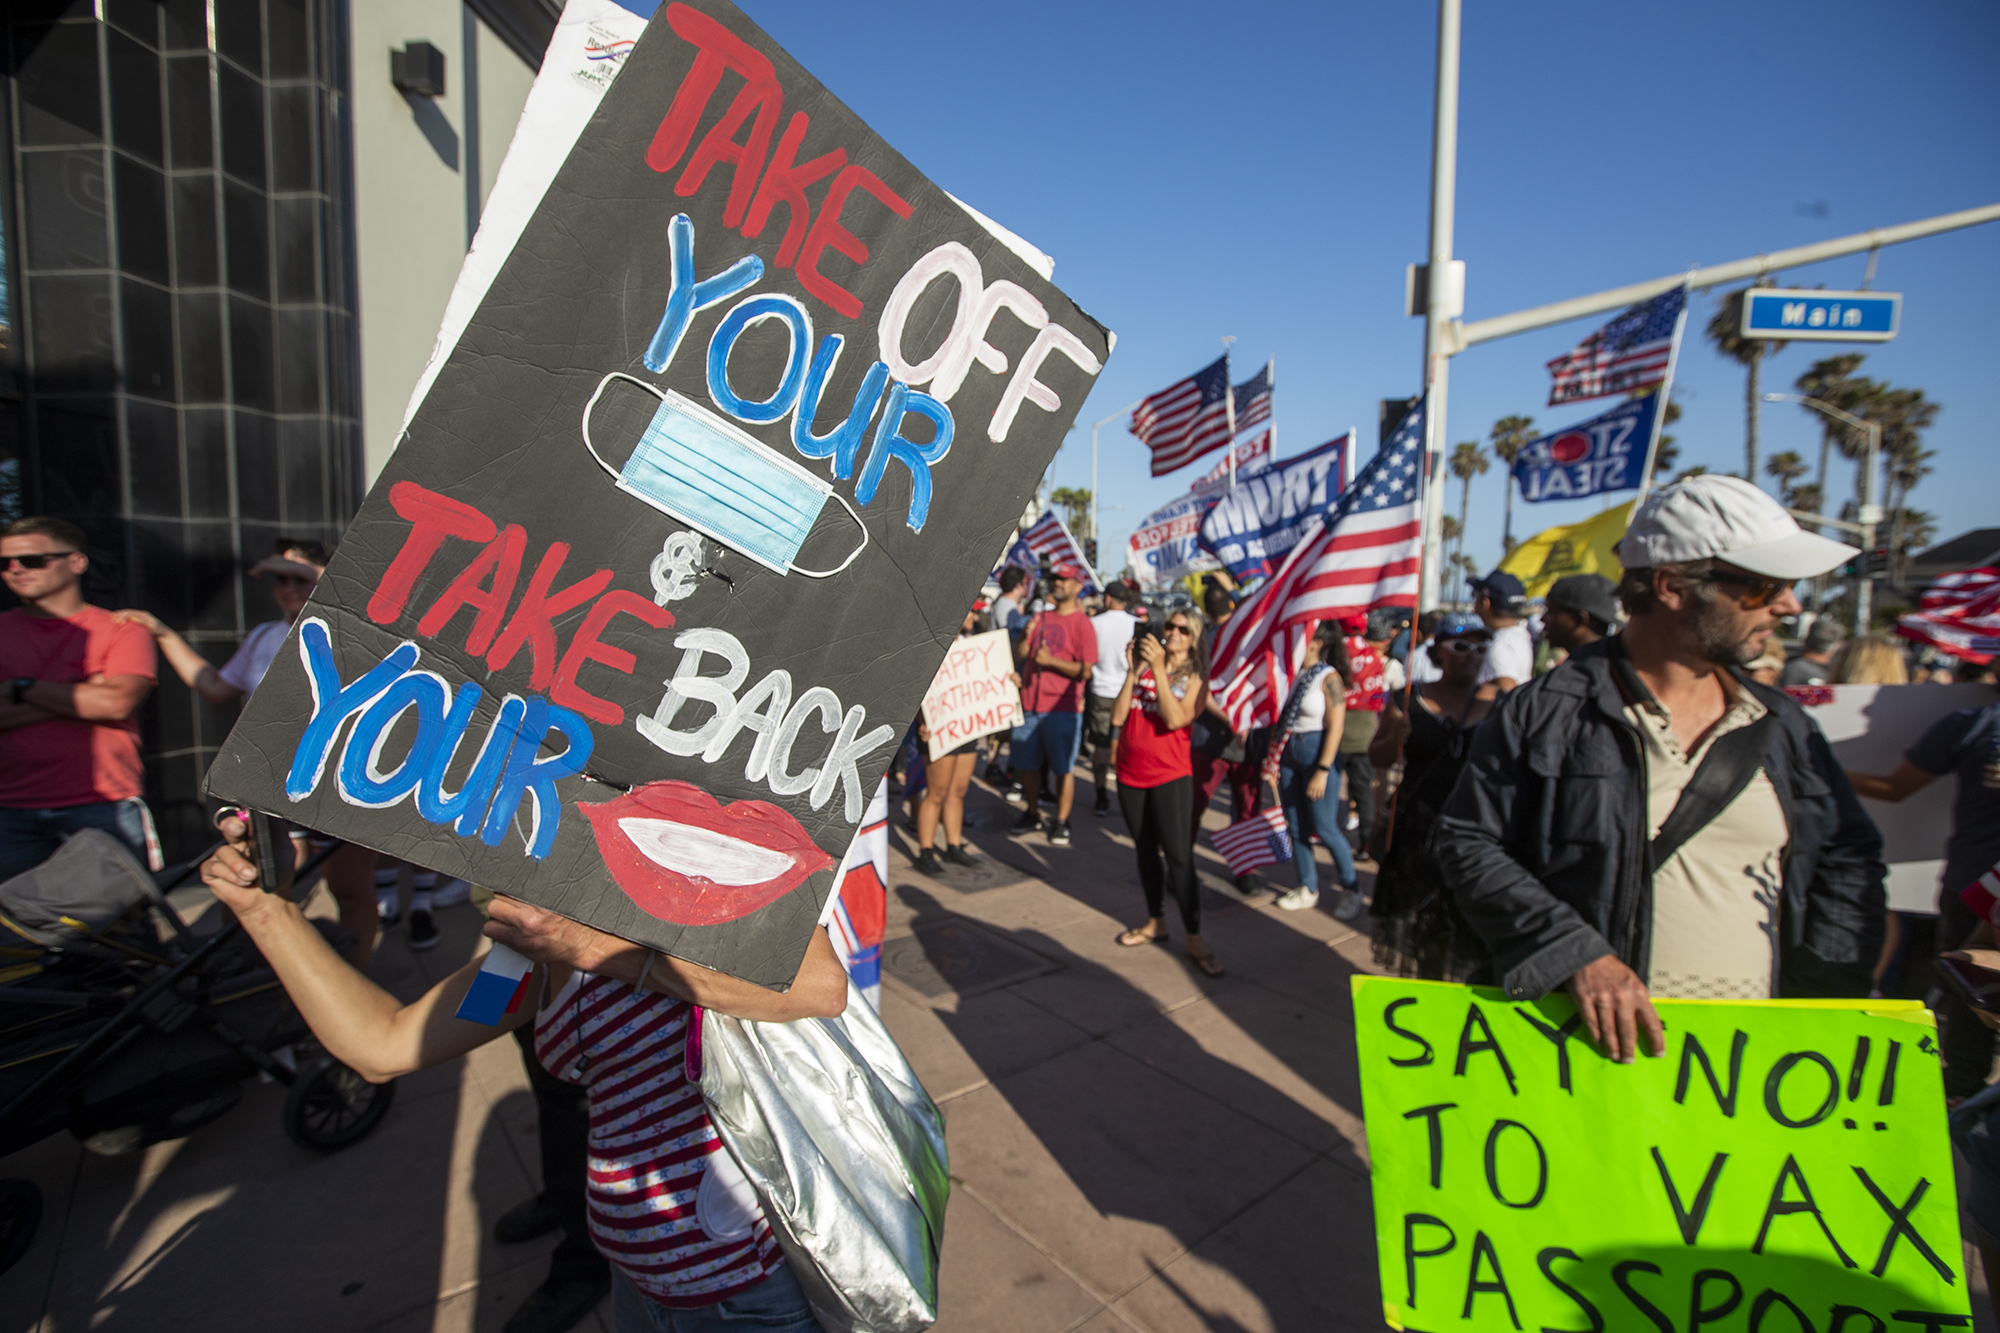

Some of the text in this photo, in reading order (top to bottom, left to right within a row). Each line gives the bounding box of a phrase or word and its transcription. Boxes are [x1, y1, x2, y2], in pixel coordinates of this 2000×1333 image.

[645, 2, 1103, 443] TAKE OFF
[643, 212, 955, 534] YOUR
[1781, 302, 1862, 328] Main
[366, 481, 896, 823] TAKE BACK
[927, 669, 1010, 725] BIRTHDAY
[935, 640, 996, 686] APPY
[285, 616, 595, 861] YOUR
[934, 703, 1015, 750] TRUMP
[1383, 996, 1582, 1096] SAY
[1402, 1102, 1957, 1286] TO VAX
[1404, 1213, 1972, 1333] PASSPO
